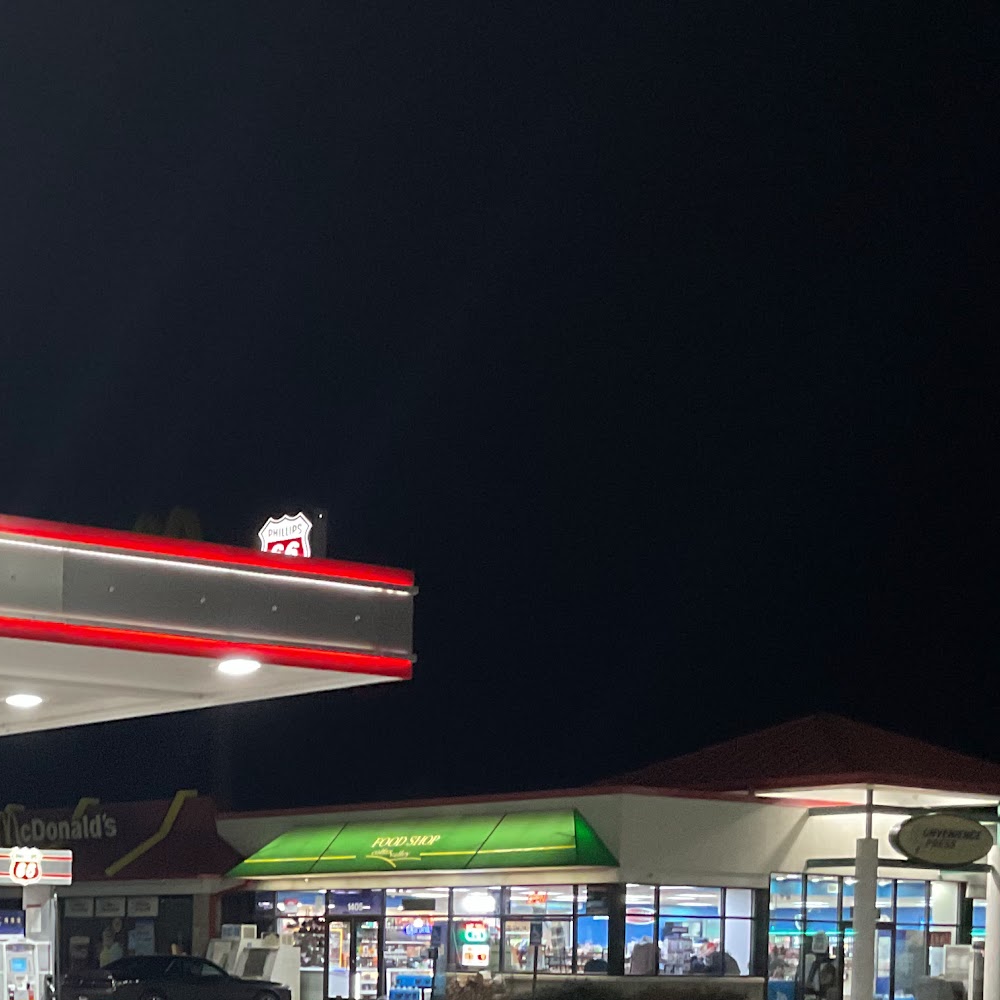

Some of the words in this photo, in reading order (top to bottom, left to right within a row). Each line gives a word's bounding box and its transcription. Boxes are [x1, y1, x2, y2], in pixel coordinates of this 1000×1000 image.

[268, 523, 303, 537] PHILLIPS
[371, 836, 408, 848] FOOD
[409, 834, 441, 846] SHOP
